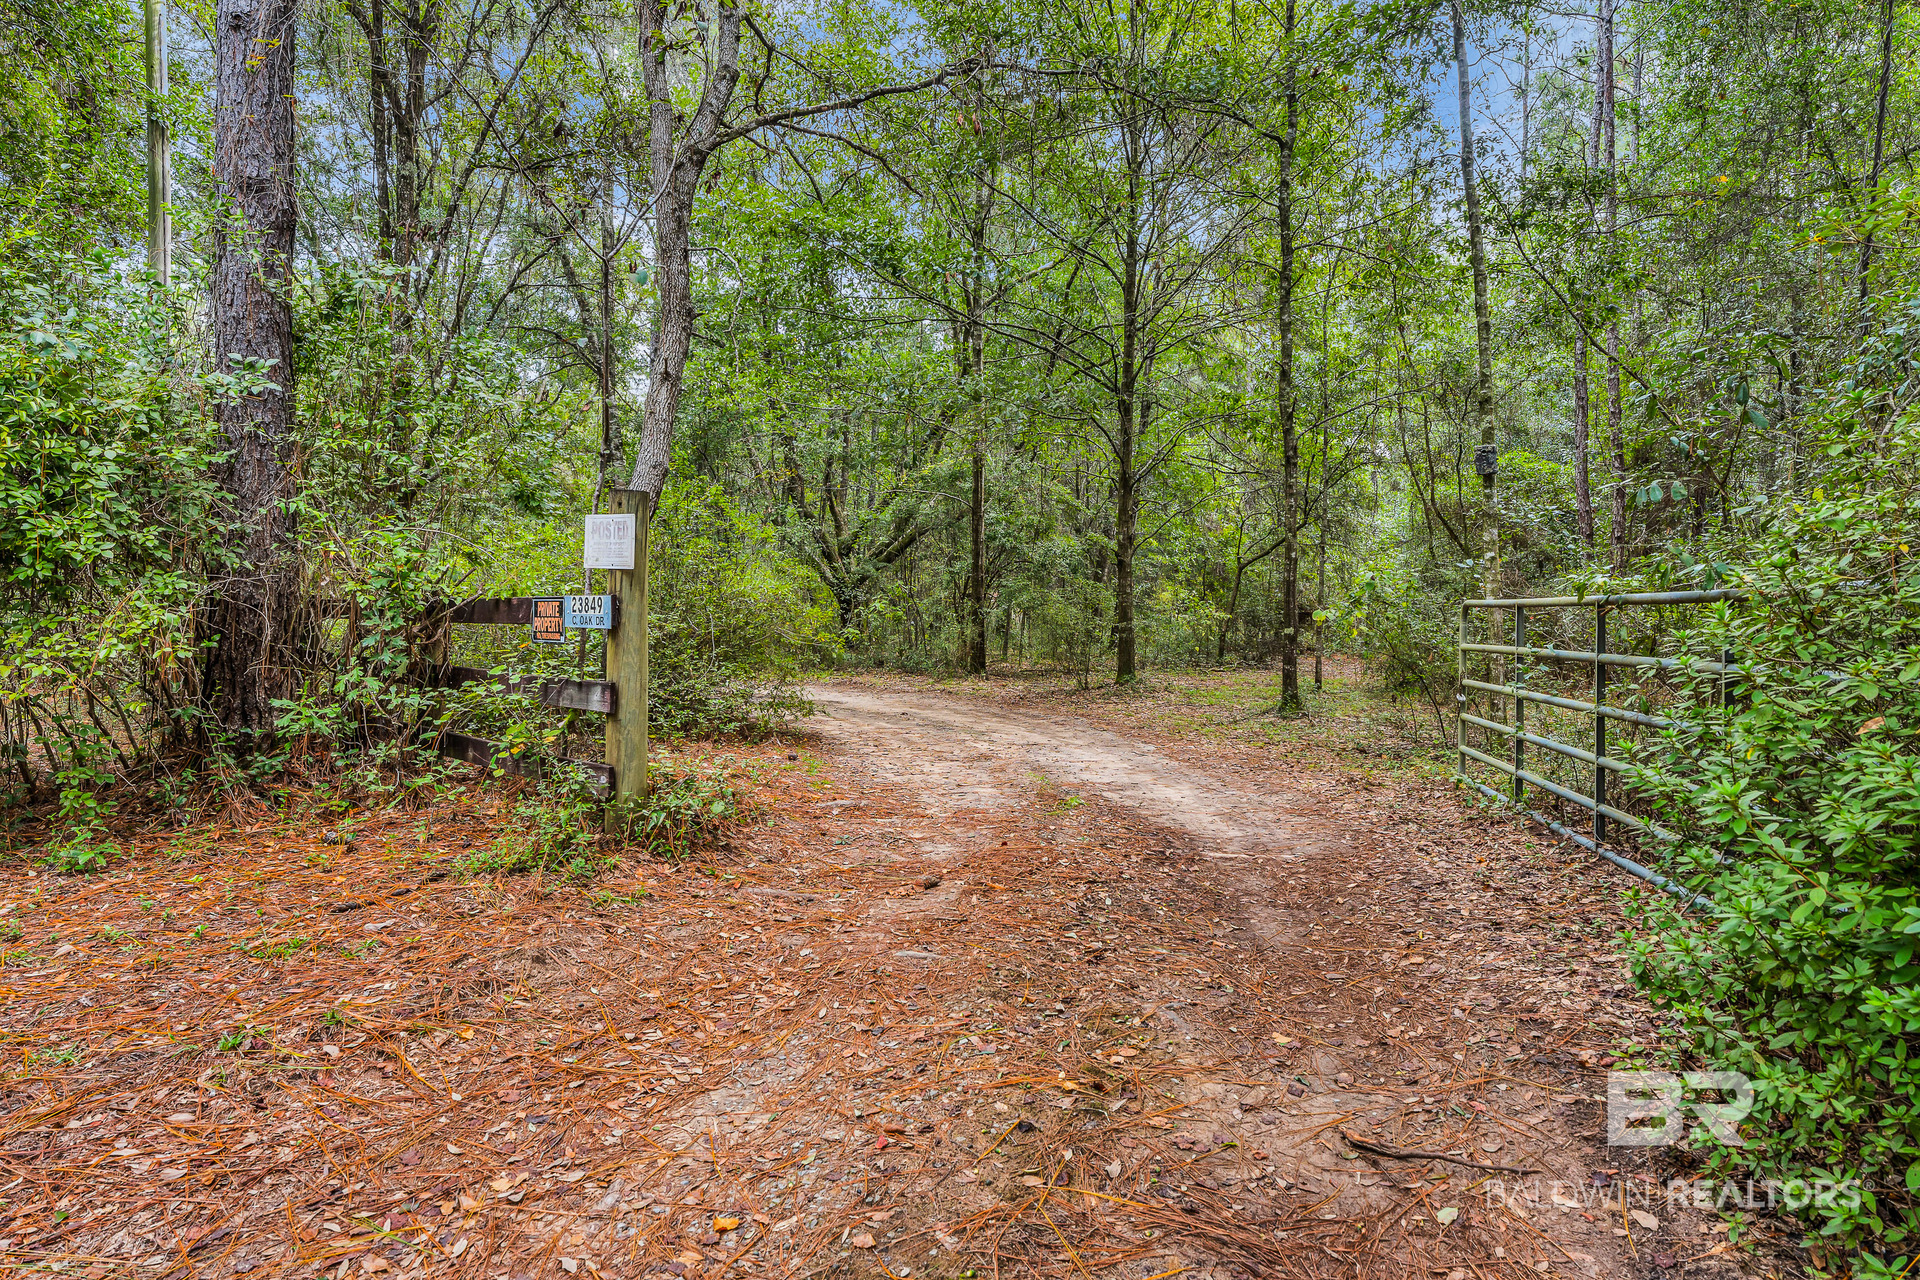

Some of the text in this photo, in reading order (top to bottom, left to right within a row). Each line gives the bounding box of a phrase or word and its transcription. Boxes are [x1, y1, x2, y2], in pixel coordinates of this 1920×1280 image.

[591, 520, 629, 540] POSTED
[537, 601, 560, 617] PRIVATE
[571, 596, 603, 613] 23849
[533, 616, 563, 632] PROPERTY
[579, 616, 594, 626] OAK
